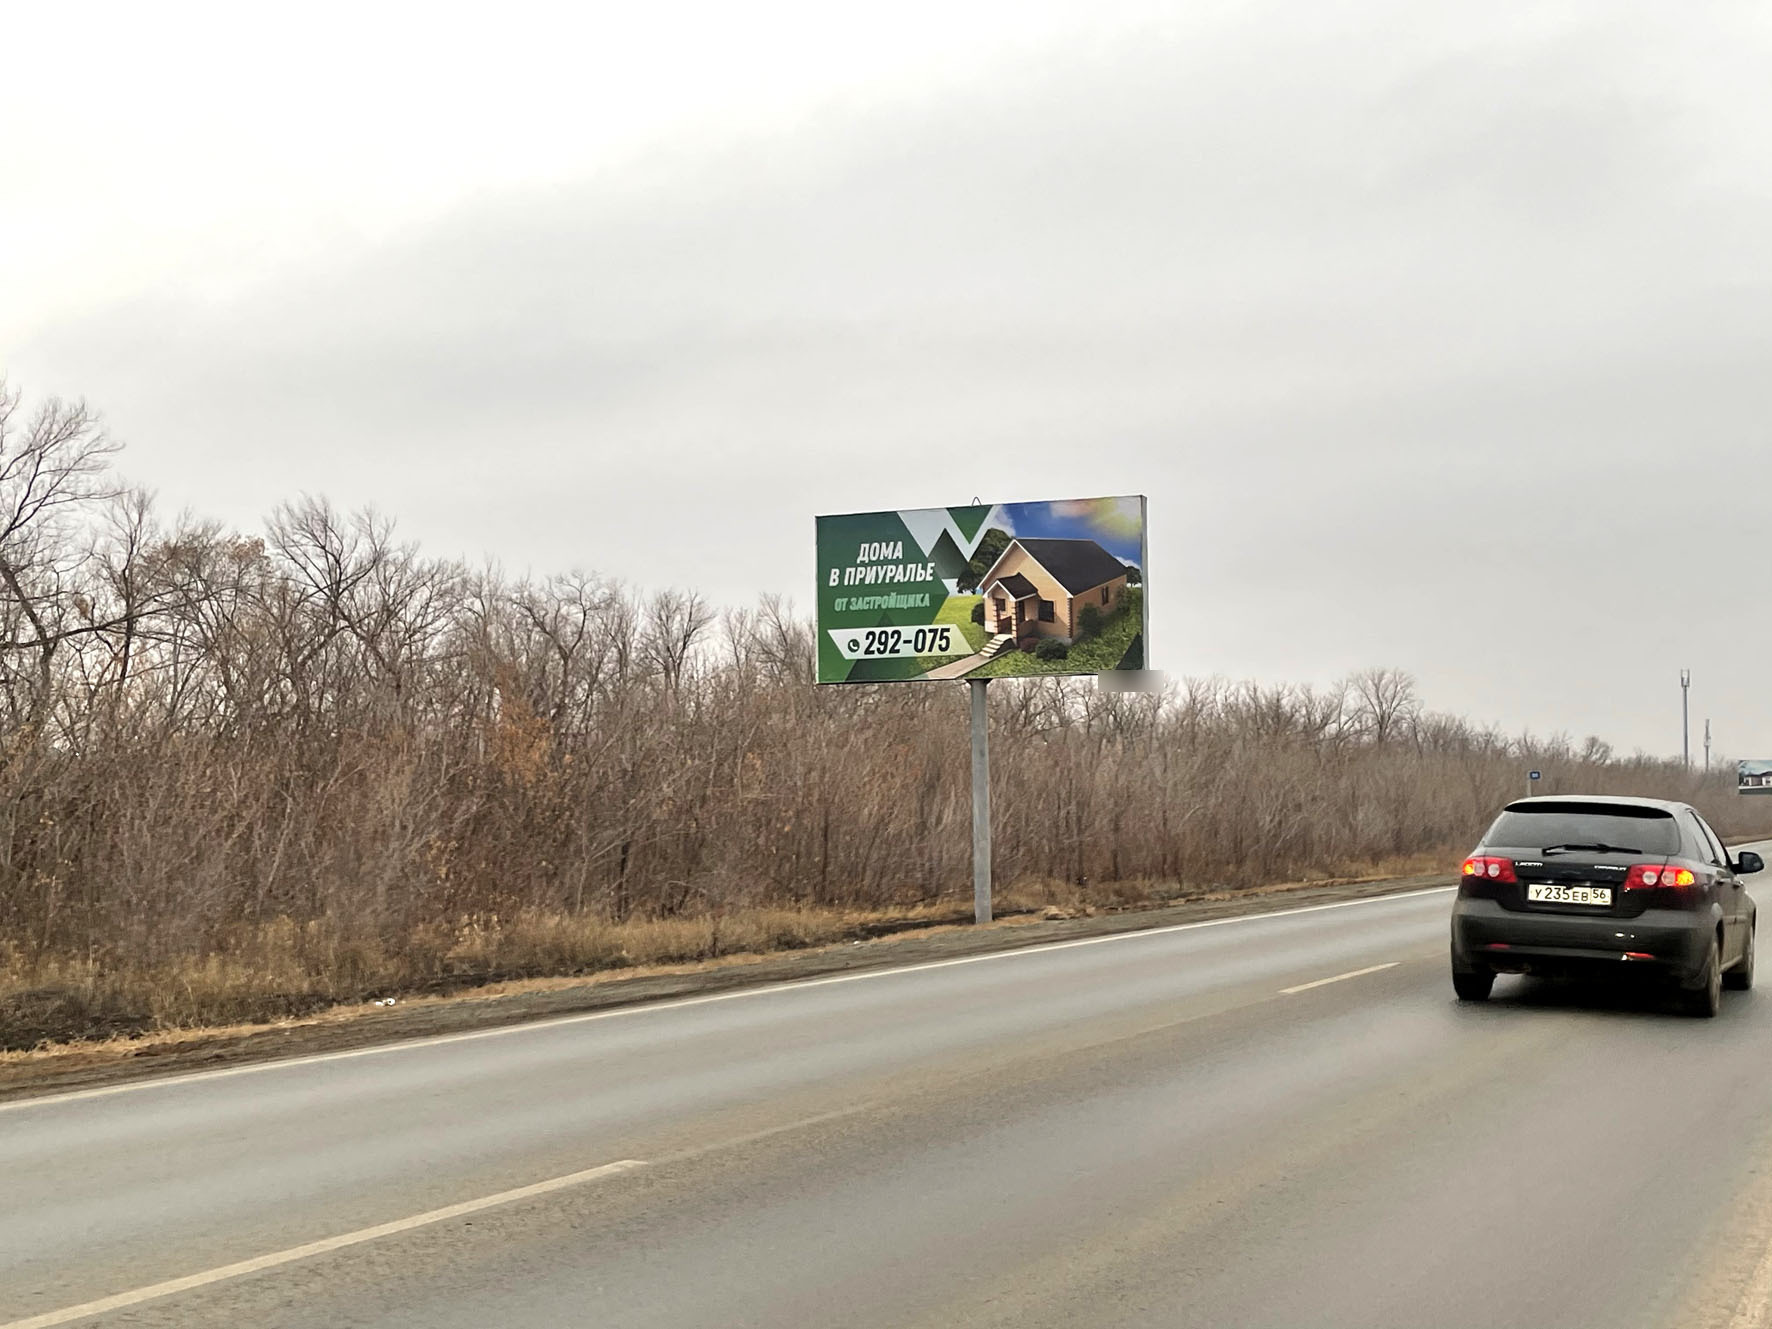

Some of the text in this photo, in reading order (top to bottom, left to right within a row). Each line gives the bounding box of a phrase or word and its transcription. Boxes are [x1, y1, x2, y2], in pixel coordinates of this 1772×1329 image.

[857, 541, 903, 564] ДОМА
[829, 562, 935, 586] В ПРИУРАЛЬЕ
[834, 592, 930, 612] ОТ ЗАСТРОЙЩИКА
[864, 628, 951, 655] 292-075
